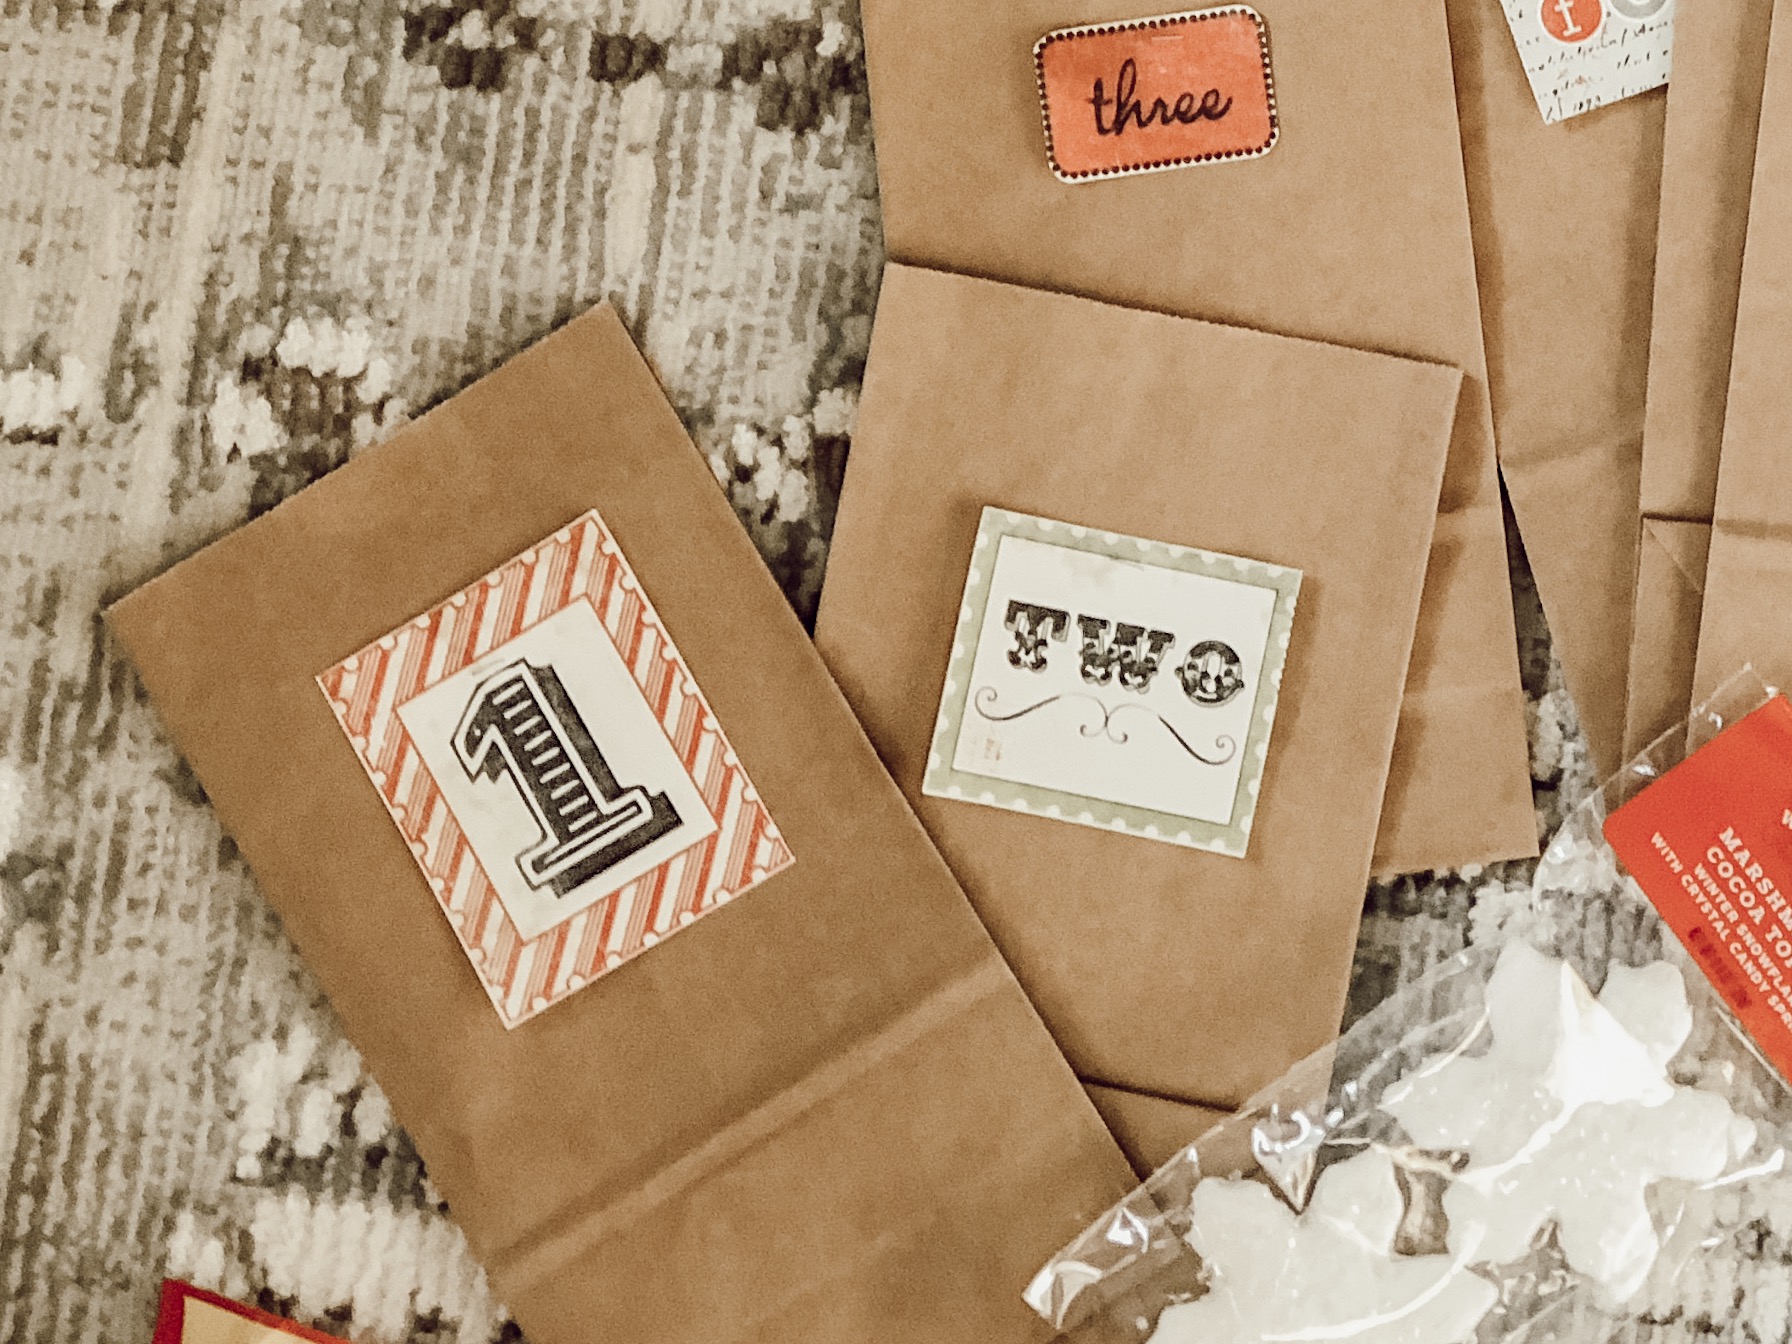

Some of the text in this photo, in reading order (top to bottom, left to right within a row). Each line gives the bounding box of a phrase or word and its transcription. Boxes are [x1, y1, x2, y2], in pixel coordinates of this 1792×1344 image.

[1085, 57, 1234, 136] three
[1004, 599, 1245, 709] TWO
[449, 657, 685, 899] 1
[1651, 831, 1684, 874] WITH
[1681, 873, 1731, 943] CRYSTAL
[1729, 941, 1772, 993] CANDY
[1694, 862, 1740, 924] WINTER
[1706, 846, 1766, 926] COCOA
